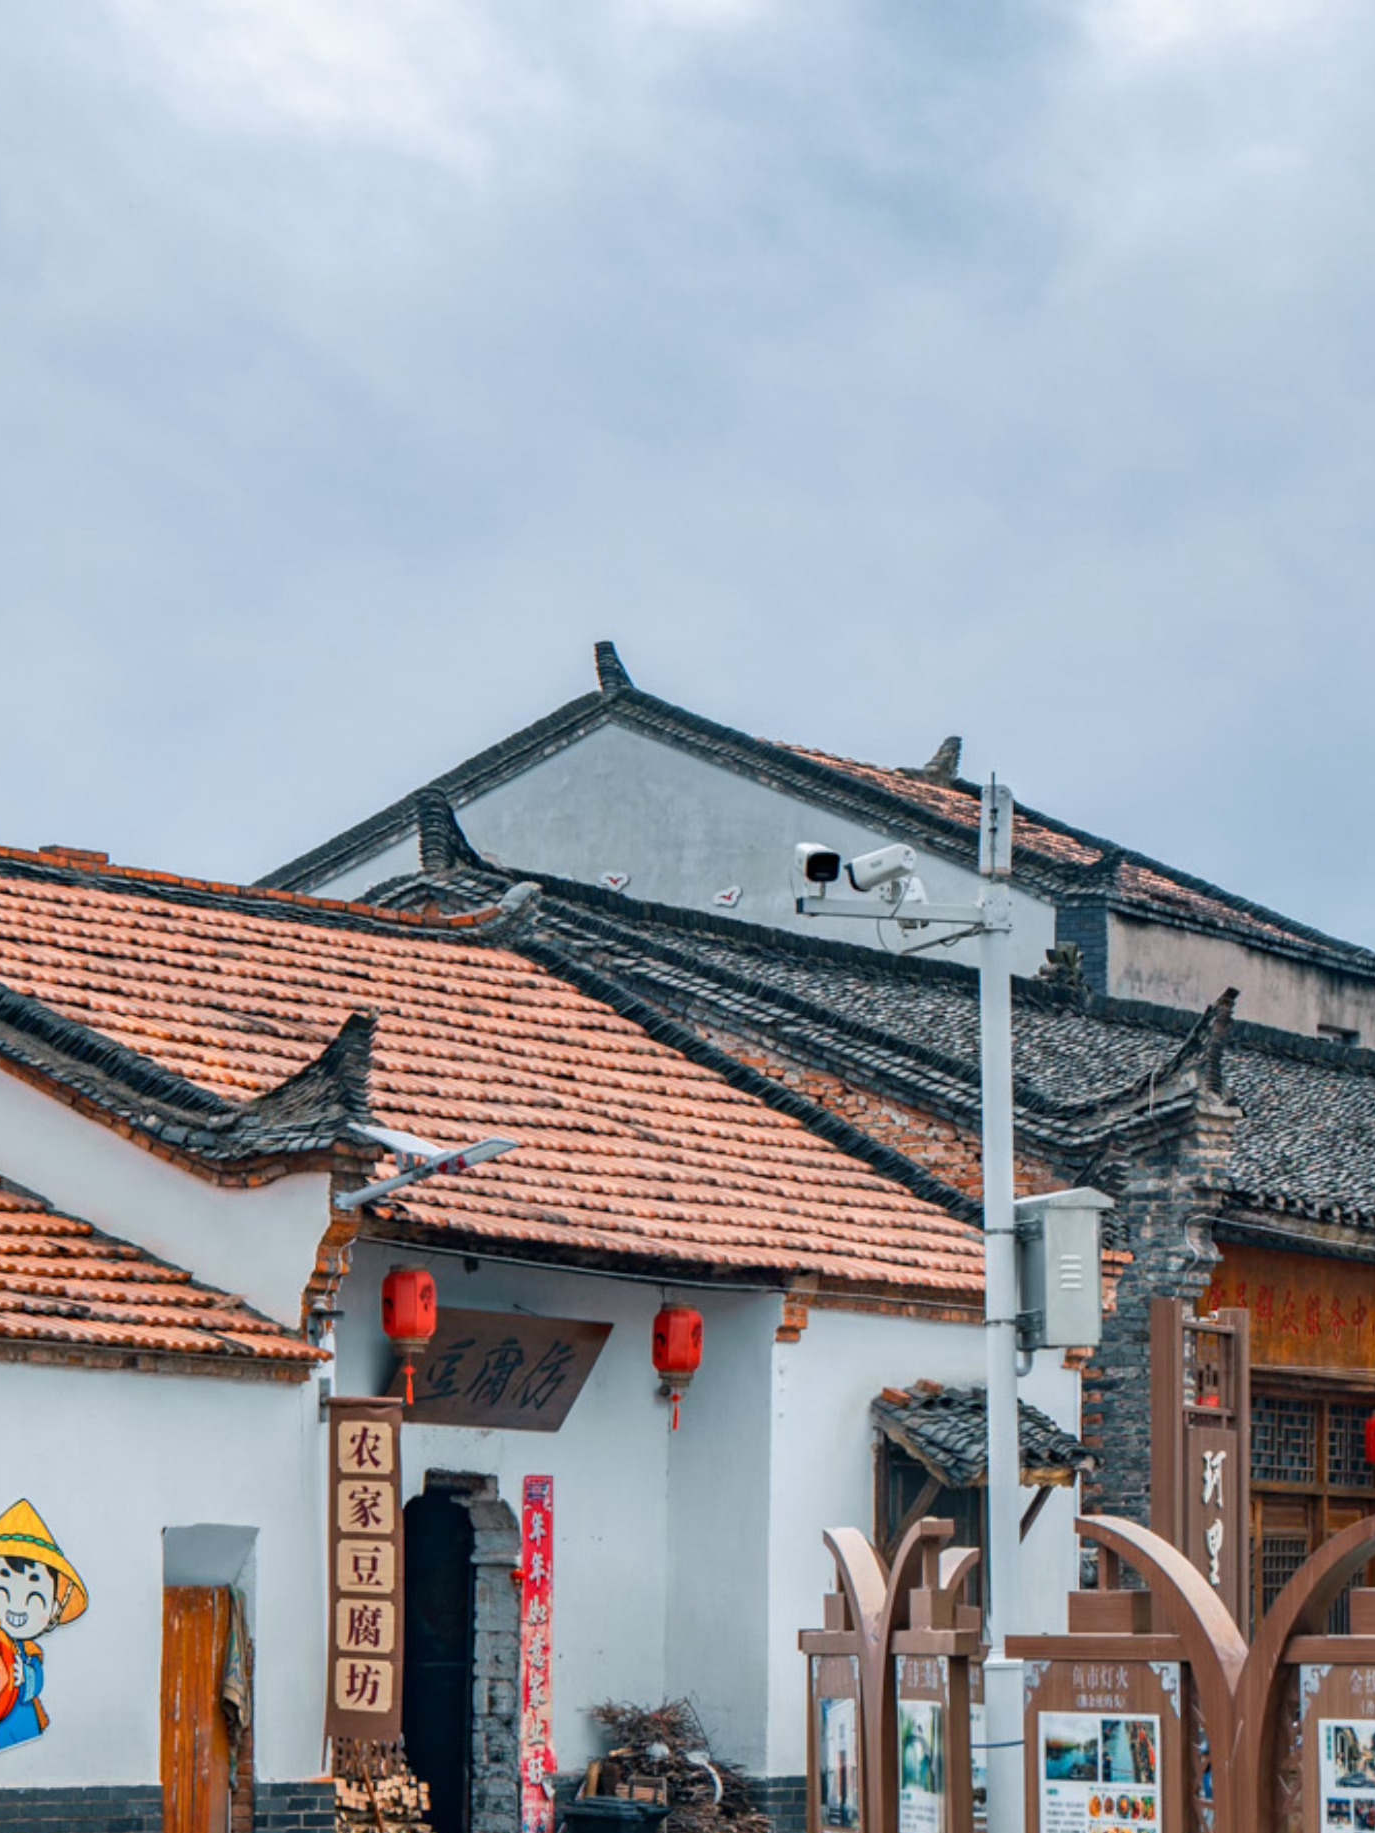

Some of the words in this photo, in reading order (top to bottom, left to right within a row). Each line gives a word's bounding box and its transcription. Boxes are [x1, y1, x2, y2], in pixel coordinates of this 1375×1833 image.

[345, 1426, 383, 1706] 农家豆腐坊
